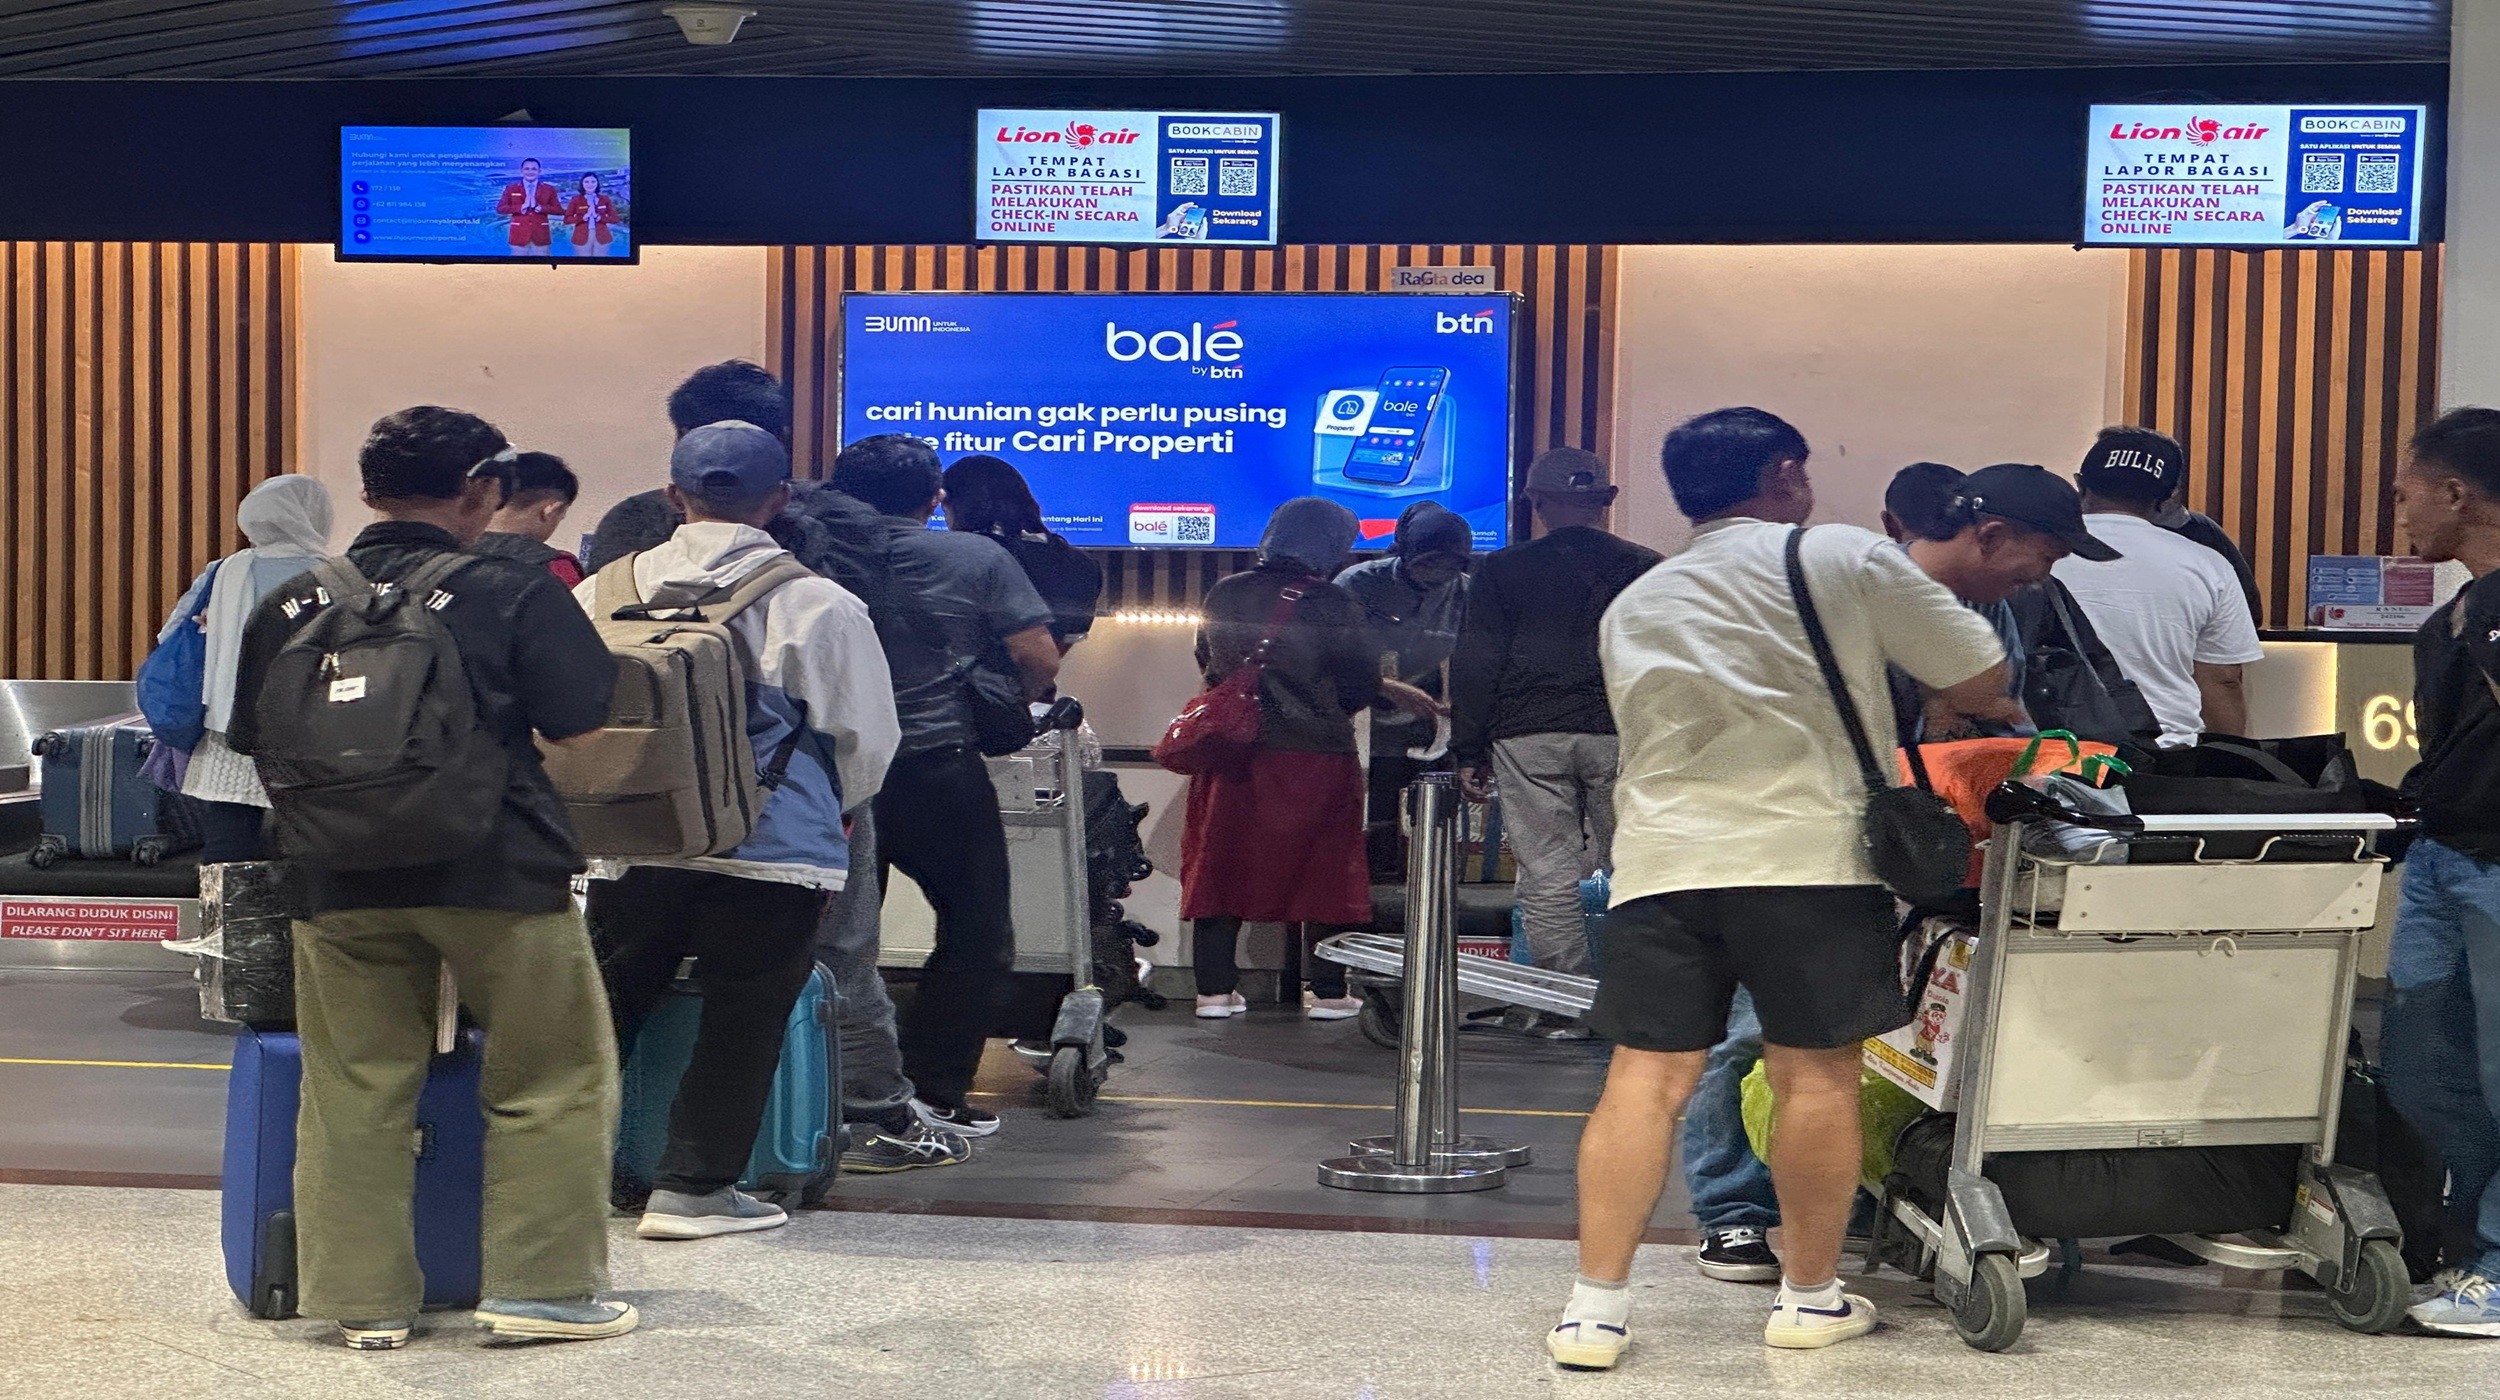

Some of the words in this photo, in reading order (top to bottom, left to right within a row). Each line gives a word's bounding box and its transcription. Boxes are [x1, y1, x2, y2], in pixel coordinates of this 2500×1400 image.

[1172, 126, 1258, 136] BOOKCABIN
[2305, 120, 2401, 130] BOOKCABIN
[996, 126, 1061, 144] Lion
[1098, 127, 1141, 145] air
[2109, 123, 2182, 140] Lion
[2222, 123, 2270, 140] air
[352, 152, 387, 160] Hubungi
[1028, 156, 1106, 167] TEMPAT
[2145, 154, 2231, 164] TEMPAT
[993, 167, 1057, 178] LAPOR
[1069, 168, 1141, 179] BAGASI
[2105, 166, 2176, 176] LAPOR
[2188, 166, 2269, 177] BAGASI
[991, 184, 1076, 196] PASTIKAN
[1080, 185, 1133, 197] TELAH
[2103, 184, 2197, 195] PASTIKAN
[2202, 184, 2260, 195] TELAH
[991, 196, 1098, 209] MELAKUKAN
[2102, 197, 2221, 208] MELAKUKAN
[991, 209, 1070, 221] CHECK-IN
[1074, 210, 1139, 222] SECARA
[1212, 209, 1262, 217] Download
[2101, 210, 2188, 222] CHECK-IN
[2193, 210, 2266, 222] SECARA
[2347, 208, 2403, 216] Download
[1212, 217, 1259, 227] Sekarang
[2346, 216, 2399, 225] Sekarang
[991, 221, 1056, 233] ONLINE
[2101, 223, 2173, 235] ONLINE
[1191, 365, 1208, 377] by
[865, 400, 923, 421] cari
[928, 401, 1032, 421] hunian
[1037, 402, 1096, 427] gak
[1100, 402, 1178, 428] perlu
[1183, 402, 1287, 429] pusing
[1326, 424, 1355, 432] Properti
[944, 431, 1006, 452] fitur
[1012, 428, 1086, 452] Cari
[1093, 429, 1234, 460] Properti
[2104, 449, 2165, 479] BULLS
[6, 906, 76, 918] DILARANG
[79, 908, 129, 920] DUDUK
[132, 910, 173, 920] DISINI
[10, 925, 59, 937] PLEASE
[61, 927, 106, 938] DON'T
[107, 928, 130, 938] SIT
[131, 929, 167, 940] HERE
